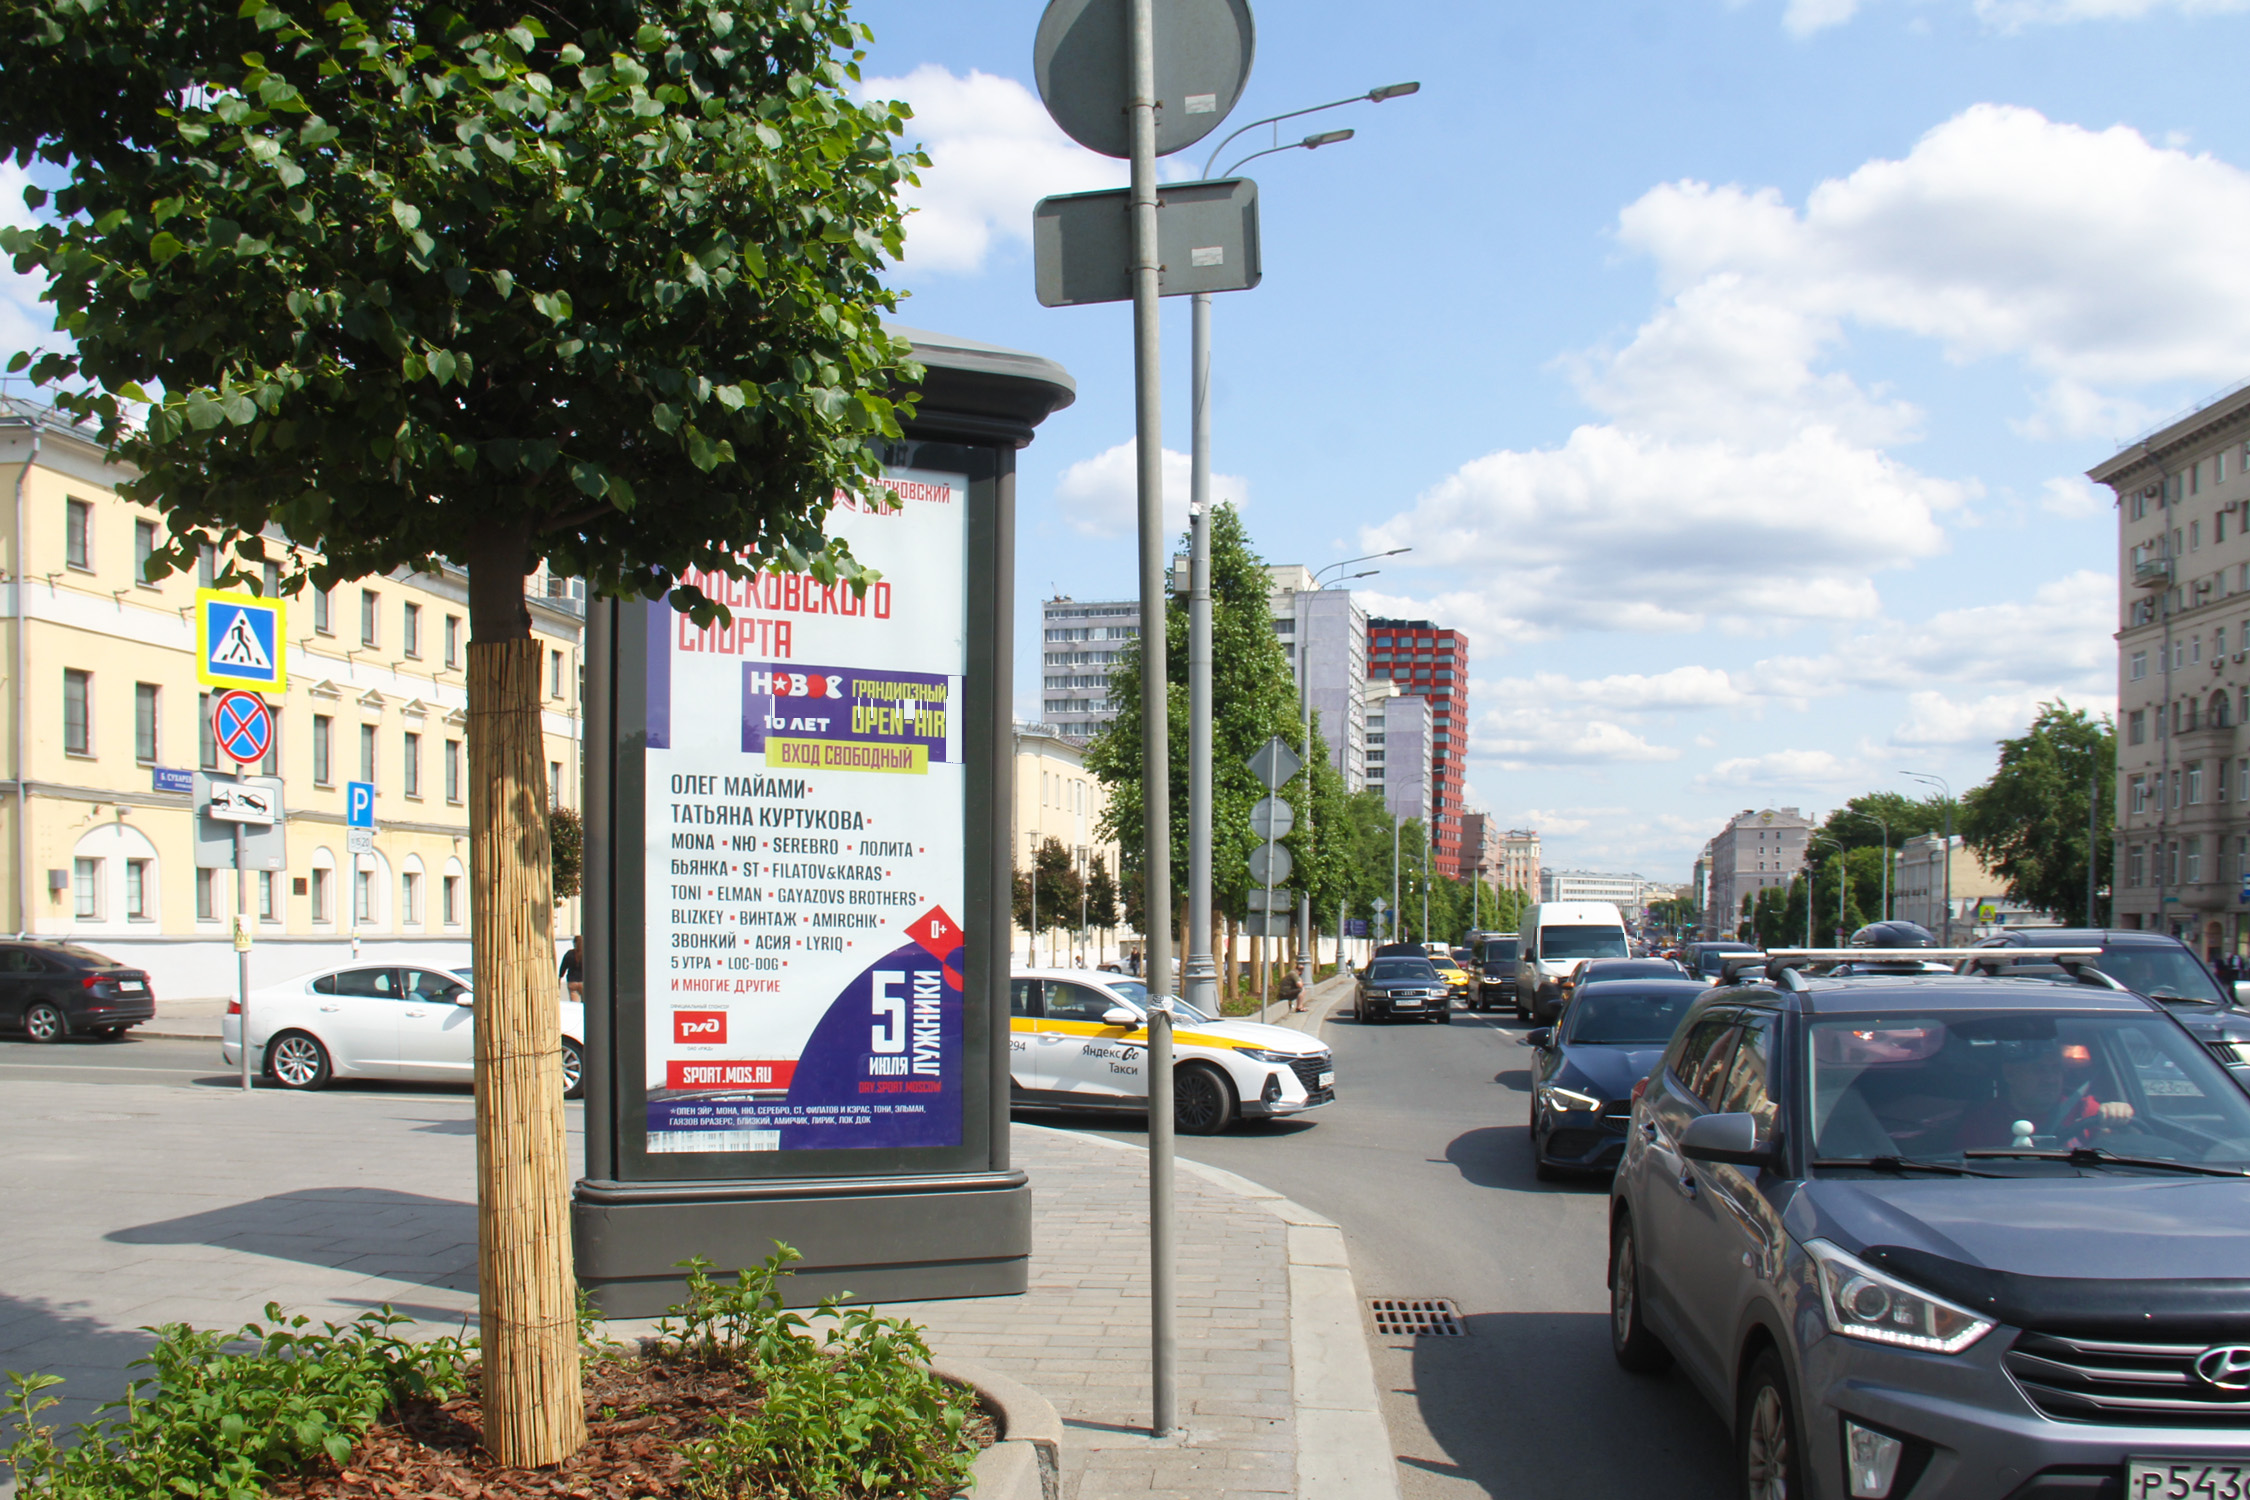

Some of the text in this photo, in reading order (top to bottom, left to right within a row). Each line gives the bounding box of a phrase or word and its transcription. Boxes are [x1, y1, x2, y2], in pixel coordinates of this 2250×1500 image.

[852, 679, 947, 703] ГРАНДИОЗНЫЙ
[764, 716, 830, 732] 10 ЛЕТ
[852, 705, 946, 738] OPEN-AIR
[782, 743, 913, 770] ВХОД СВОБОДНЫЙ
[671, 773, 806, 799] ОЛЕГ МАЙАМИ
[671, 803, 865, 831] ТАТЬЯНА КУРТУКОВА
[671, 833, 715, 850] MONA
[773, 836, 839, 855] SEREBRO
[859, 840, 914, 857] ЛОЛИТА
[671, 859, 882, 881] БЬЯНКА ST FILATOV&KARAS
[671, 884, 917, 907] TONI ELMAN GAYAZOVS BROTHERS
[672, 908, 878, 928] BLIZKEY ВИНТАЖ AMIRCHIK
[930, 920, 948, 939] 0+
[672, 931, 843, 953] ЗВОНКИЙ АСИЯ LYRIQ
[671, 956, 779, 971] 5 УТРА LOC-DOG
[671, 978, 781, 994] И МНОГИЕ ДРУГИЕ
[872, 970, 906, 1054] 5
[912, 970, 941, 1076] ЛУЖНИКИ
[1082, 1044, 1140, 1061] Яндекс Go
[683, 1066, 772, 1084] SPORT.MOS.RU
[869, 1057, 908, 1076] ИЮЛЯ
[1108, 1062, 1138, 1075] Такси
[858, 1081, 942, 1094] DAY.SPORT.MOSCOW
[2142, 1465, 2250, 1500] Р543
